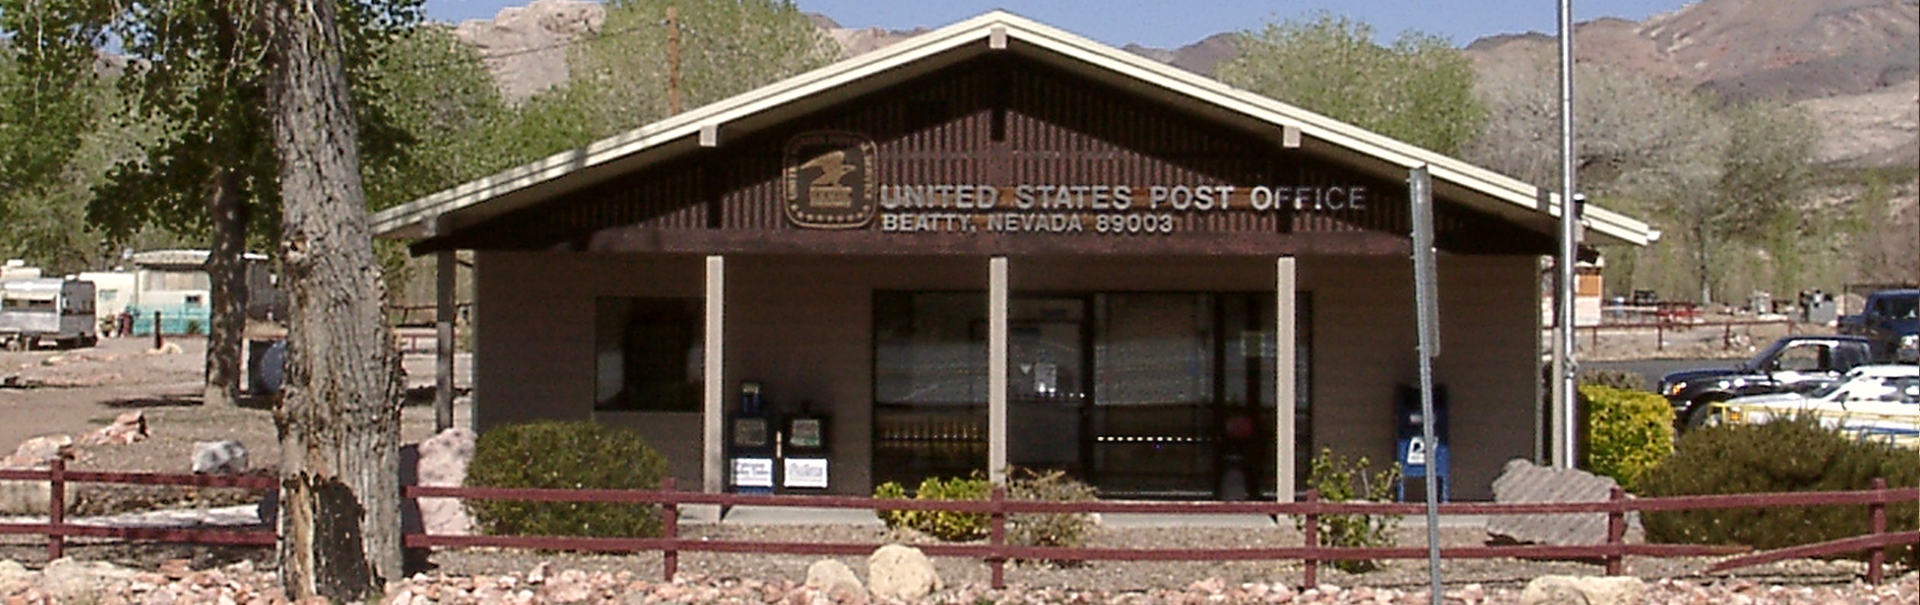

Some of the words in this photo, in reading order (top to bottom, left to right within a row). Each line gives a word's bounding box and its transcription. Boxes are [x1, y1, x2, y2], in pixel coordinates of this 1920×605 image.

[880, 184, 999, 210] UNITED
[1014, 184, 1132, 210] STATES
[1149, 184, 1235, 211] POST
[1250, 185, 1366, 211] OFFICE
[882, 213, 978, 233] BEATTY,
[987, 213, 1084, 232] NEVADA
[1094, 213, 1174, 233] 89003
